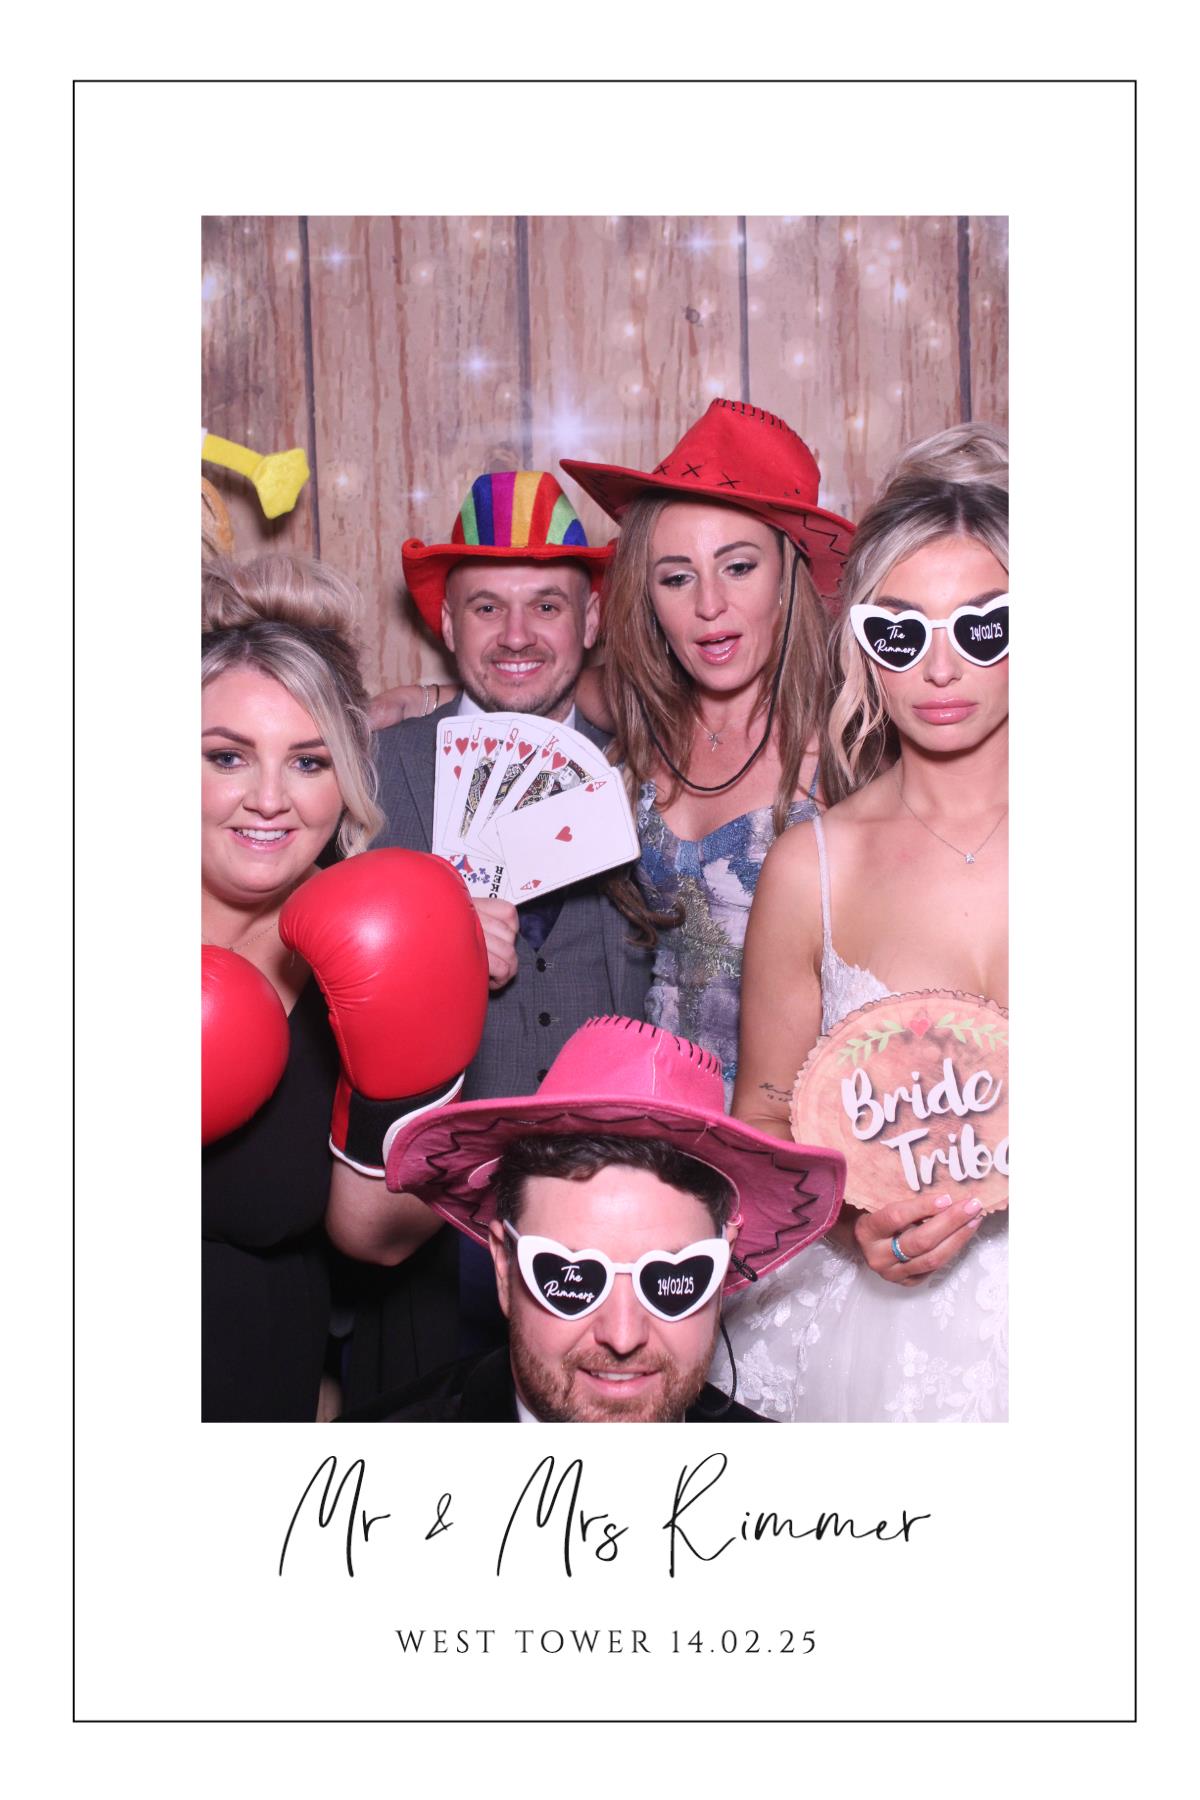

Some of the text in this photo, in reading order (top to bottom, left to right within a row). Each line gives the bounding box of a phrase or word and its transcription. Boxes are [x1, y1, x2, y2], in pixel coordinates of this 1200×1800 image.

[887, 625, 905, 639] The
[969, 622, 1003, 641] 14/02/25
[874, 638, 917, 657] Rimmers
[472, 727, 482, 741] J
[509, 728, 519, 742] Q
[547, 735, 559, 750] K
[594, 780, 607, 790] A
[489, 866, 504, 899] OKER
[841, 1057, 1002, 1140] Bride
[561, 1265, 583, 1283] The
[543, 1280, 595, 1303] Rimmers
[657, 1275, 694, 1296] 14/02/25
